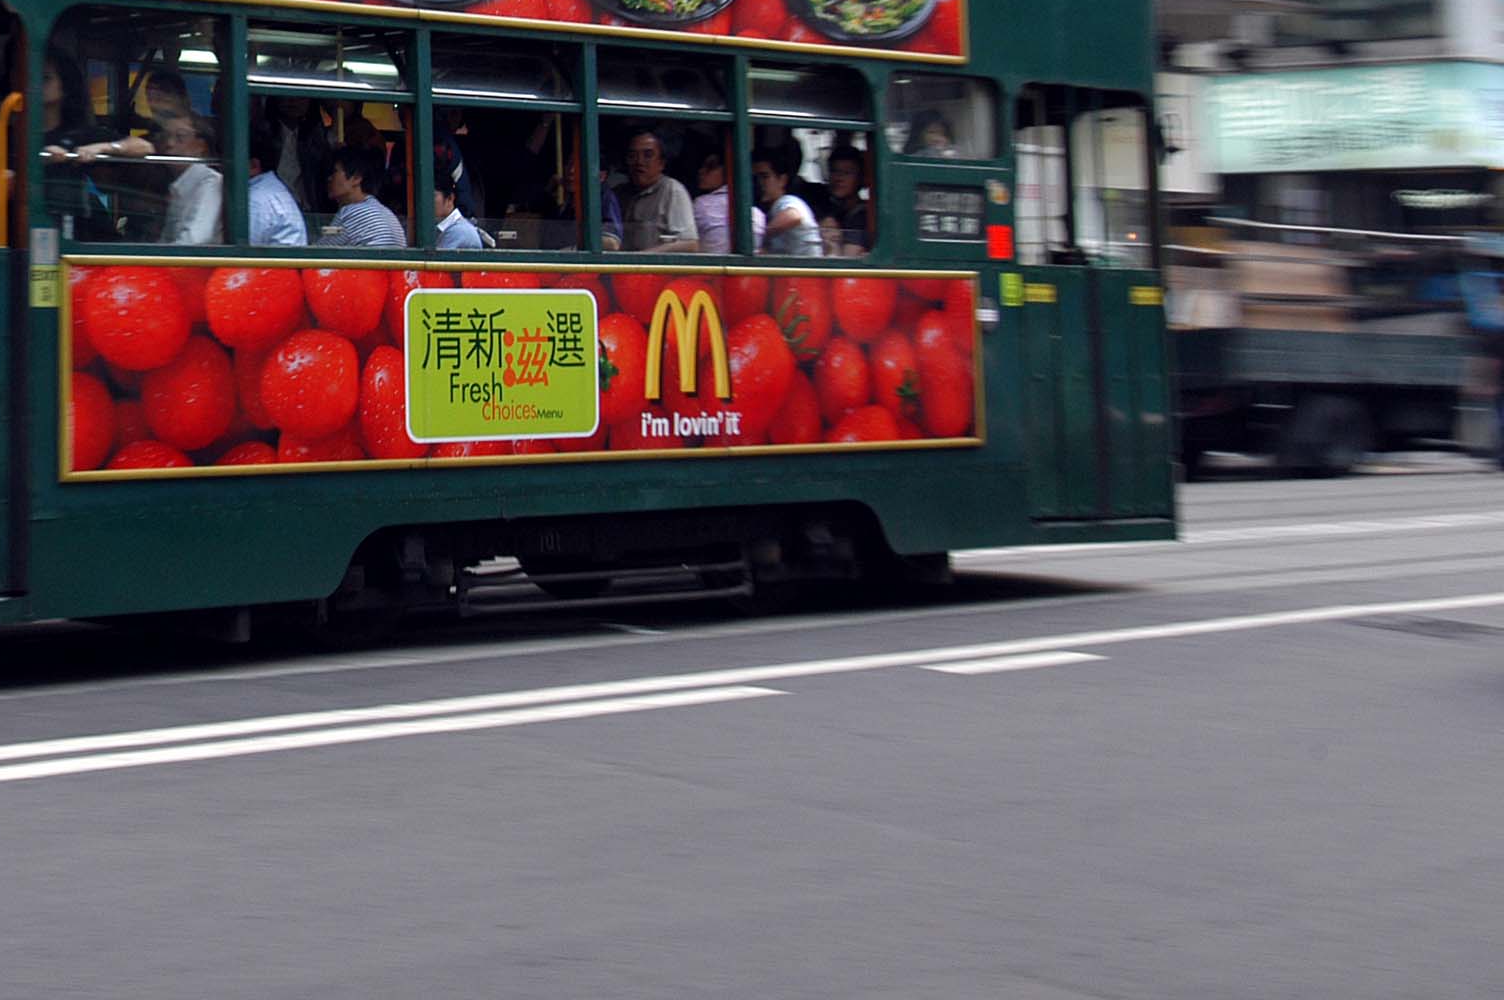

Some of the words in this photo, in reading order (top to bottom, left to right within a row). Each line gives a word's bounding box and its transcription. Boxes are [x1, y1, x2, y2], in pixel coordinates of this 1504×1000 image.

[422, 308, 586, 387] 清新滋選
[450, 372, 503, 403] Fresh
[537, 408, 564, 419] Menu
[641, 411, 670, 437] i'm
[673, 411, 724, 437] lovin'
[725, 411, 742, 436] it
